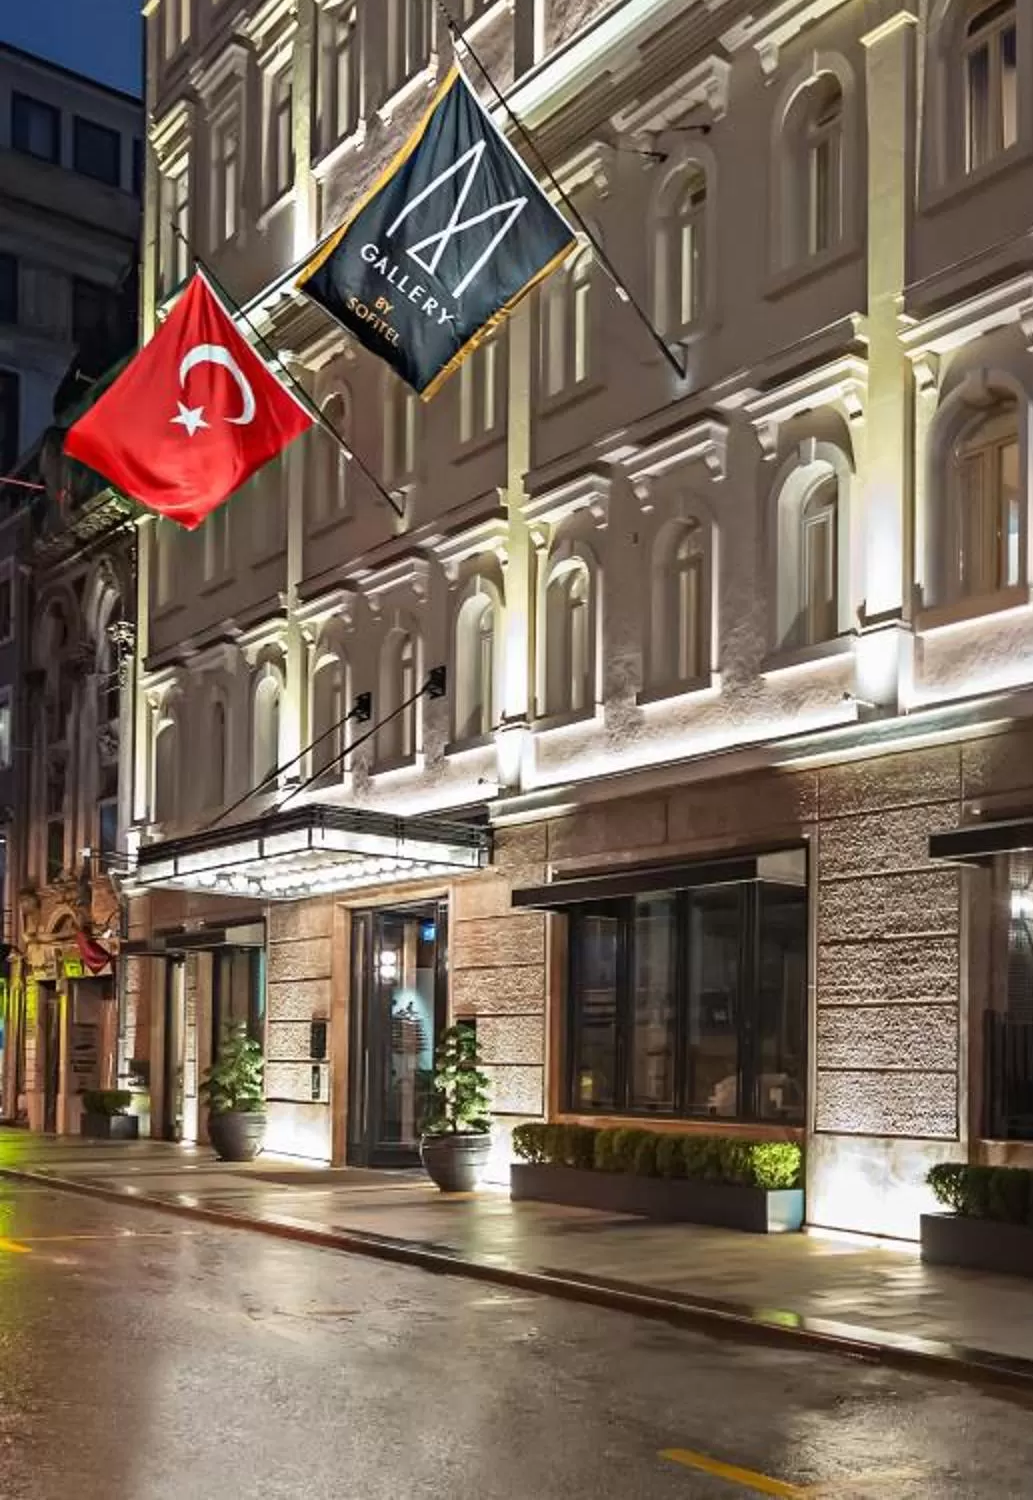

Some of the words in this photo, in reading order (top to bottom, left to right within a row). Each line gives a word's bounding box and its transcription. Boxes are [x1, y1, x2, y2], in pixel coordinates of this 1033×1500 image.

[360, 243, 455, 325] GALLERY
[374, 296, 394, 315] BY
[346, 297, 400, 347] SOFITEL
